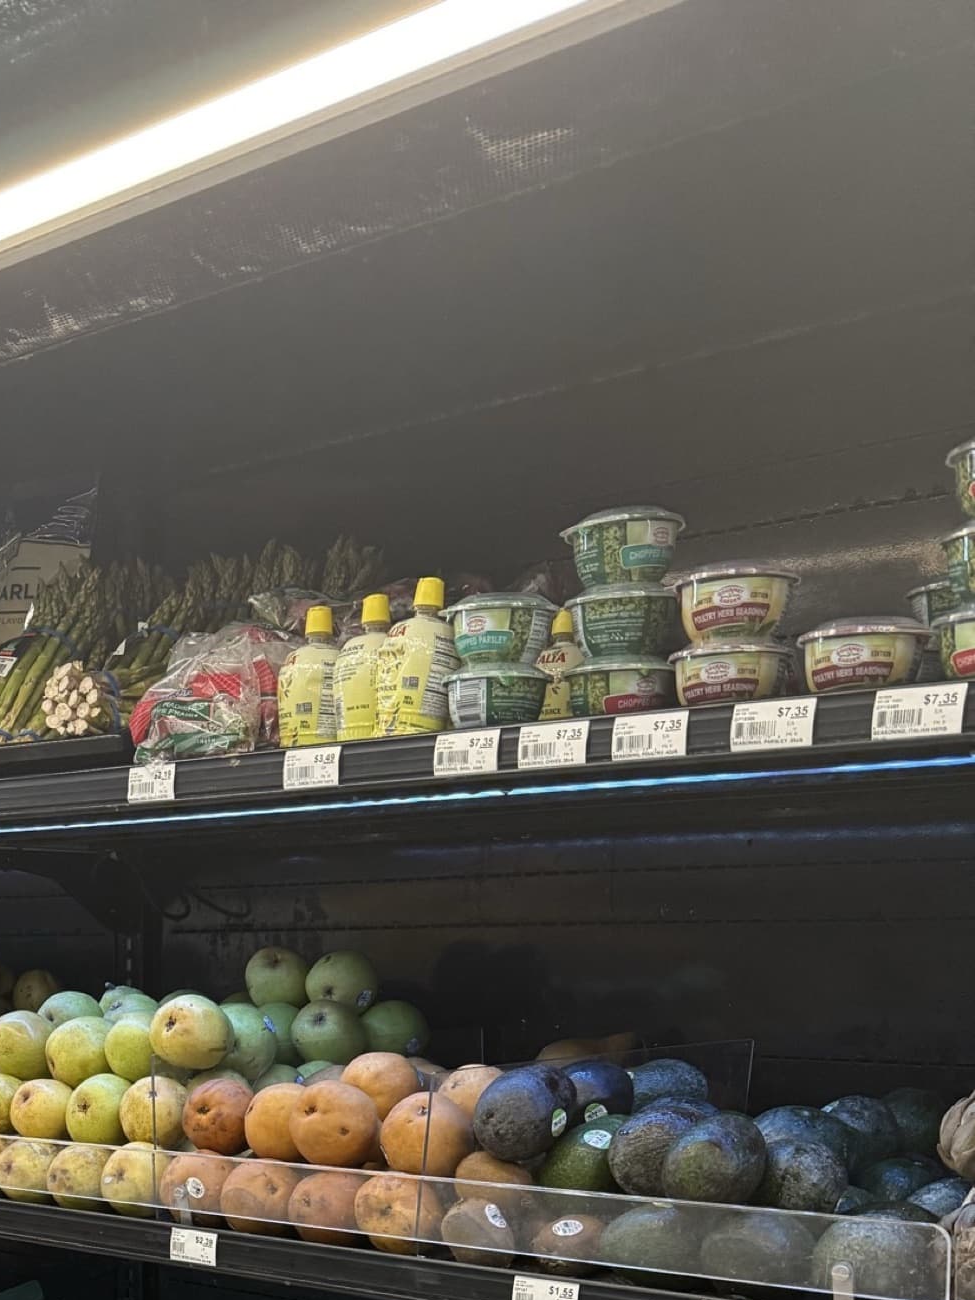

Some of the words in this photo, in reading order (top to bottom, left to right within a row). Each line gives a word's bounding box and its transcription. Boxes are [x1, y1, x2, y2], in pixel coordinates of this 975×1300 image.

[924, 692, 958, 706] $7.35
[777, 705, 809, 719] $7.35
[653, 719, 682, 732] $7.35
[556, 728, 583, 740] $7.35
[469, 738, 494, 748] $7.35
[314, 753, 336, 764] $3.49
[548, 1285, 574, 1299] $1.55
